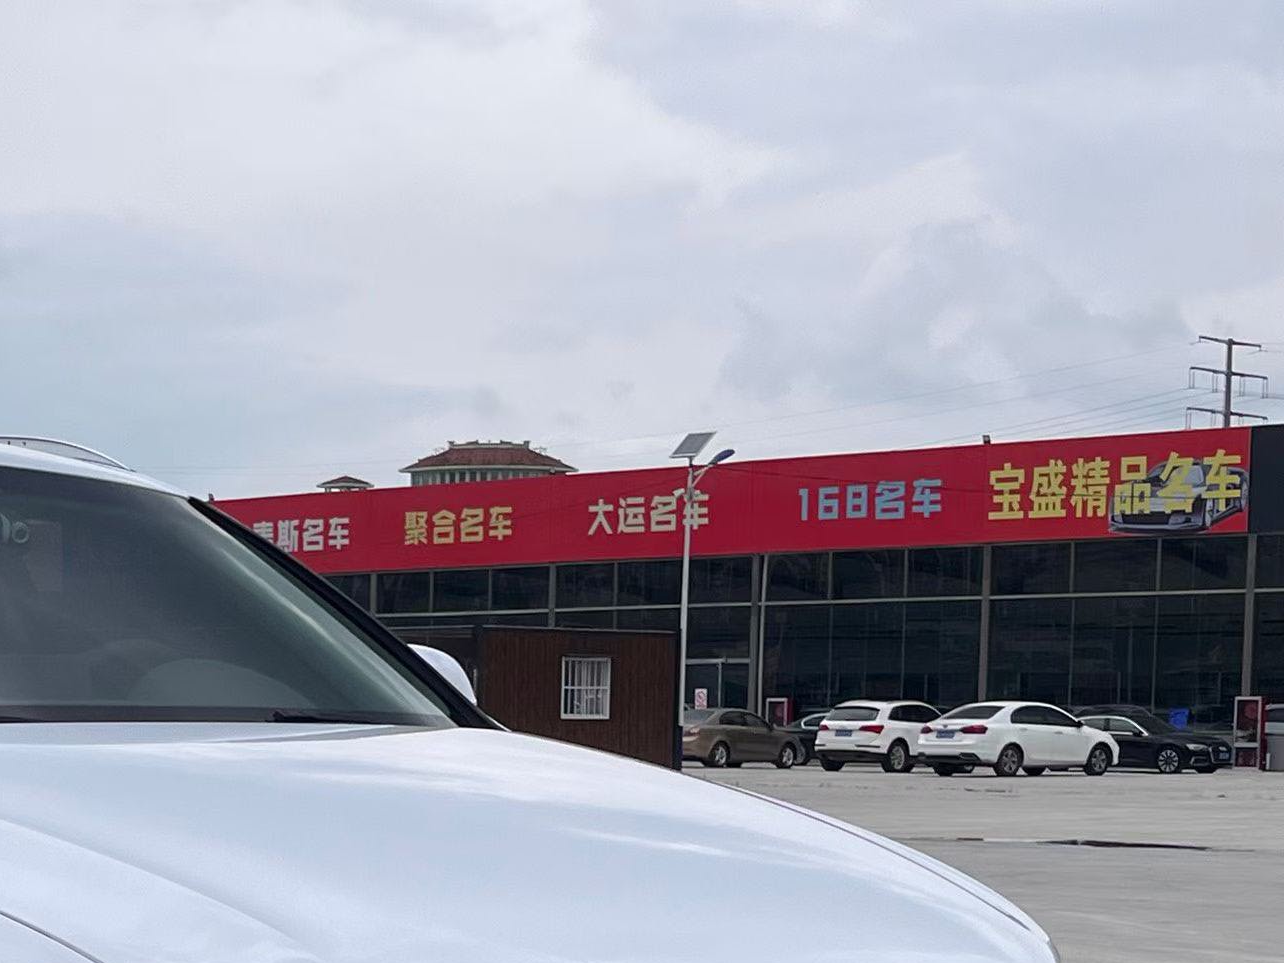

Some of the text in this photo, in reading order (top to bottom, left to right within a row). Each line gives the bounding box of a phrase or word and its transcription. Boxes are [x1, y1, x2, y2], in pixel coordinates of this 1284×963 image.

[798, 478, 943, 522] 168名车
[987, 449, 1243, 521] 宝盛精品名车
[404, 506, 513, 545] 聚合名车
[588, 490, 710, 535] 大运名车
